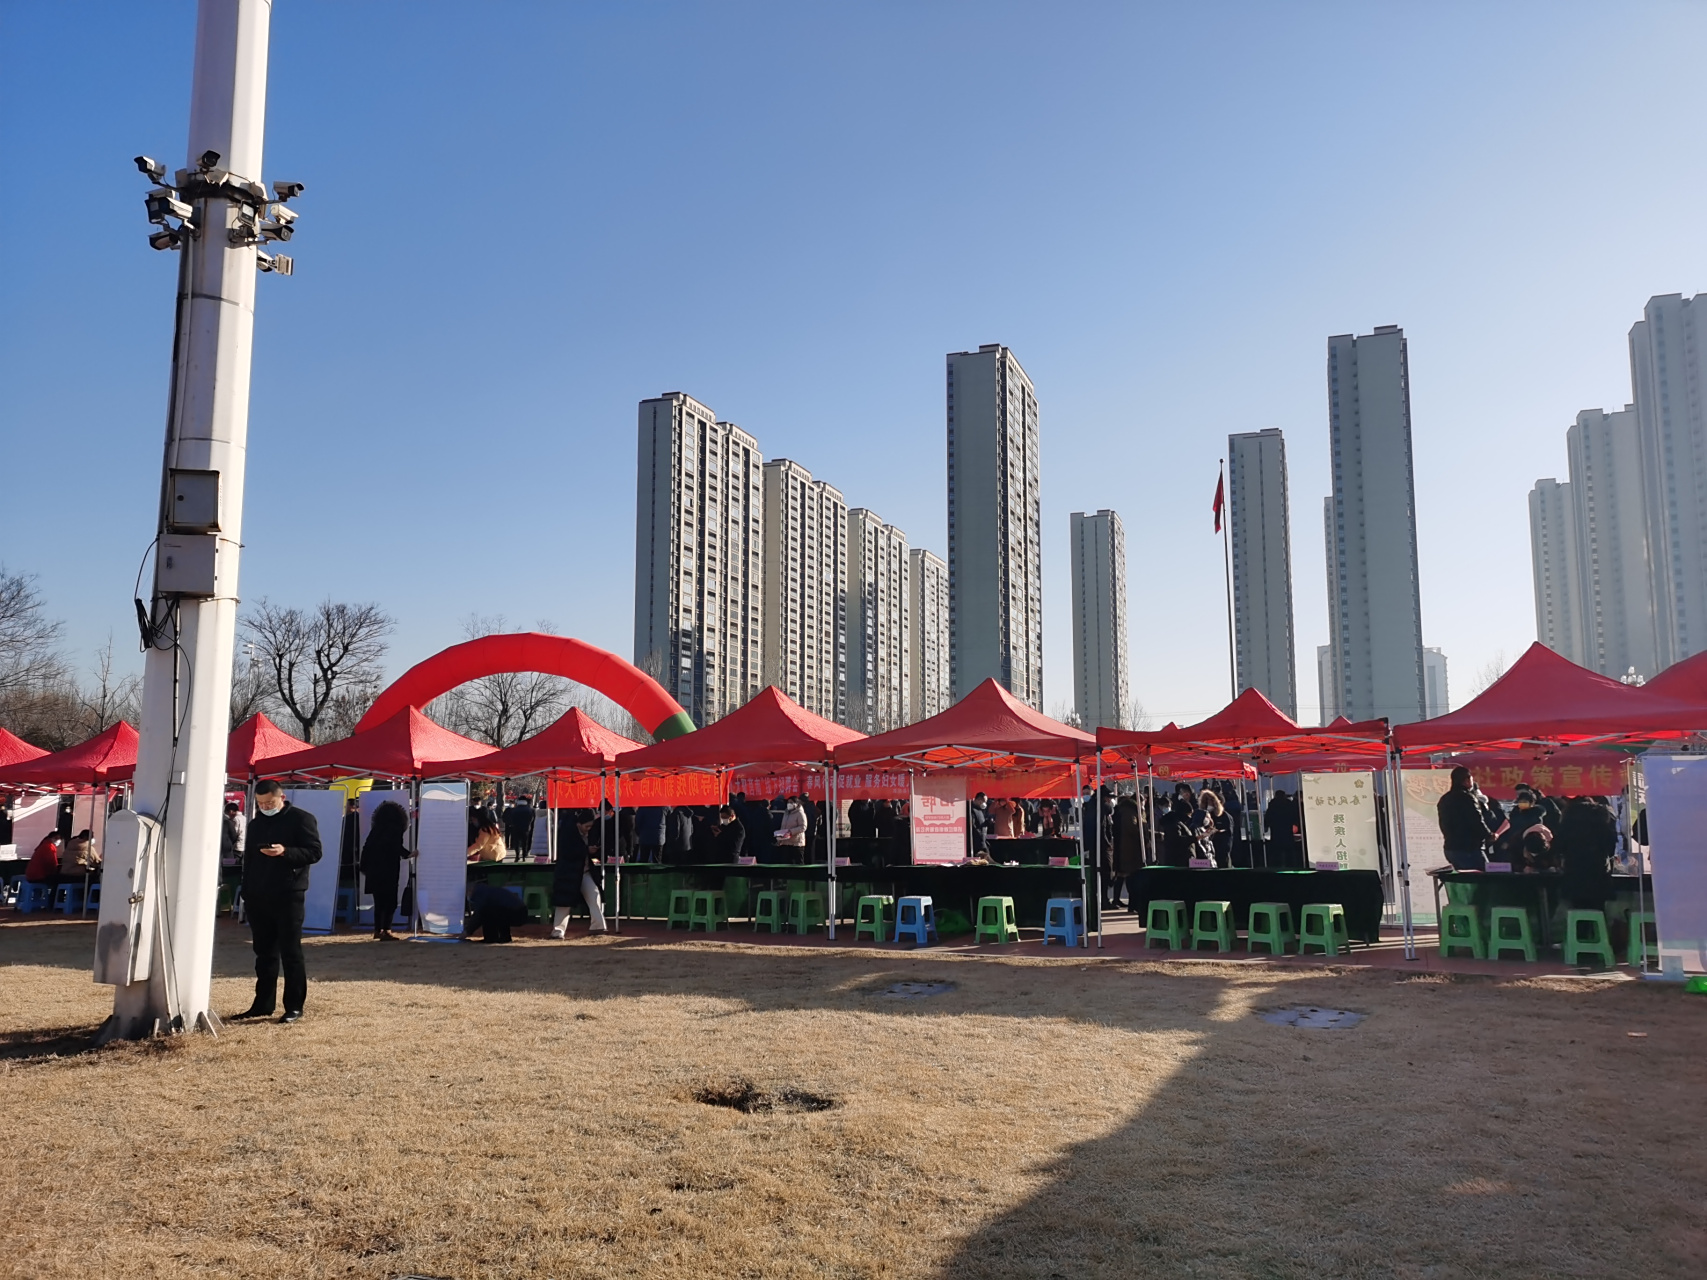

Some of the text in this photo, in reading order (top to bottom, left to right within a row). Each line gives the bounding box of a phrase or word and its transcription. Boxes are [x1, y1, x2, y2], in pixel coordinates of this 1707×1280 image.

[1159, 765, 1169, 776] 69
[1476, 765, 1627, 789] 社政策宣传
[865, 773, 909, 788] 服务妇女暖
